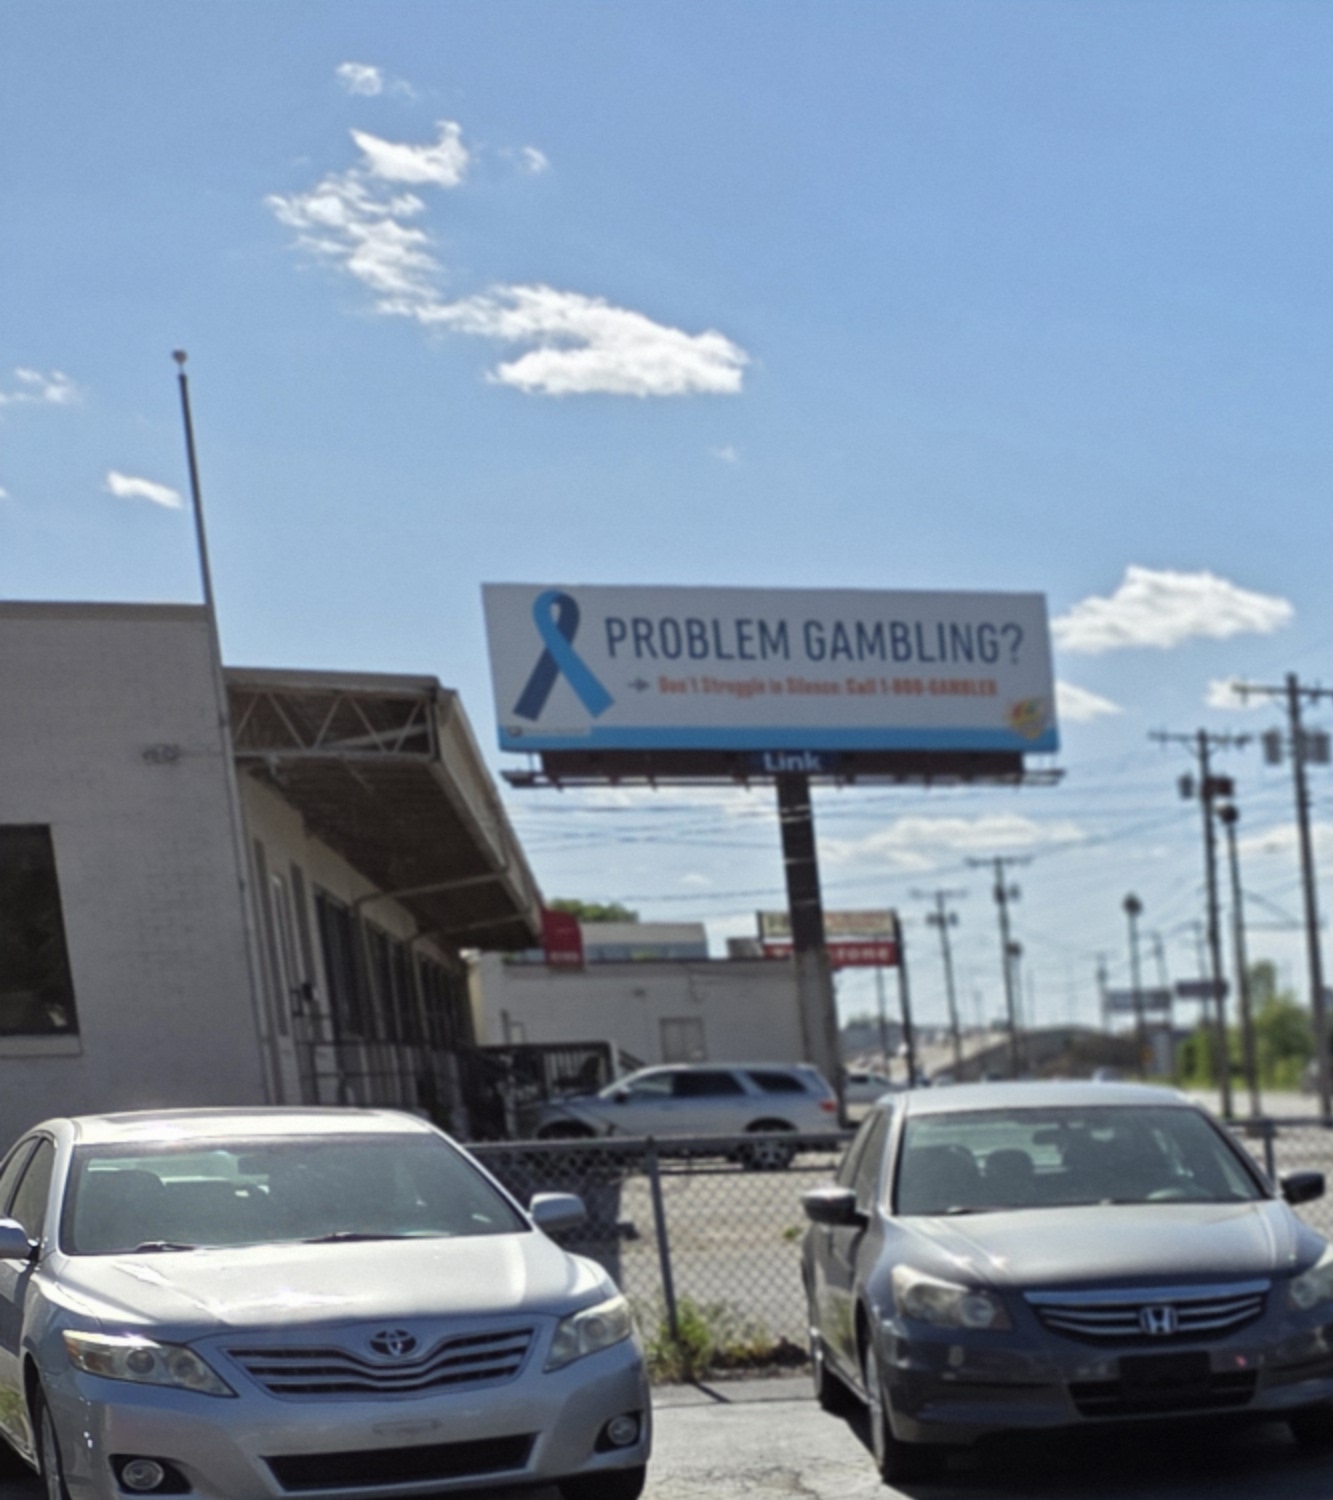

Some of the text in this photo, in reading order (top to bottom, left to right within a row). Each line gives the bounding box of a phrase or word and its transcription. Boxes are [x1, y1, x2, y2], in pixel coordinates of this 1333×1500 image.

[604, 616, 1024, 664] PROBLEM GAMBLING?
[763, 750, 821, 772] Link
